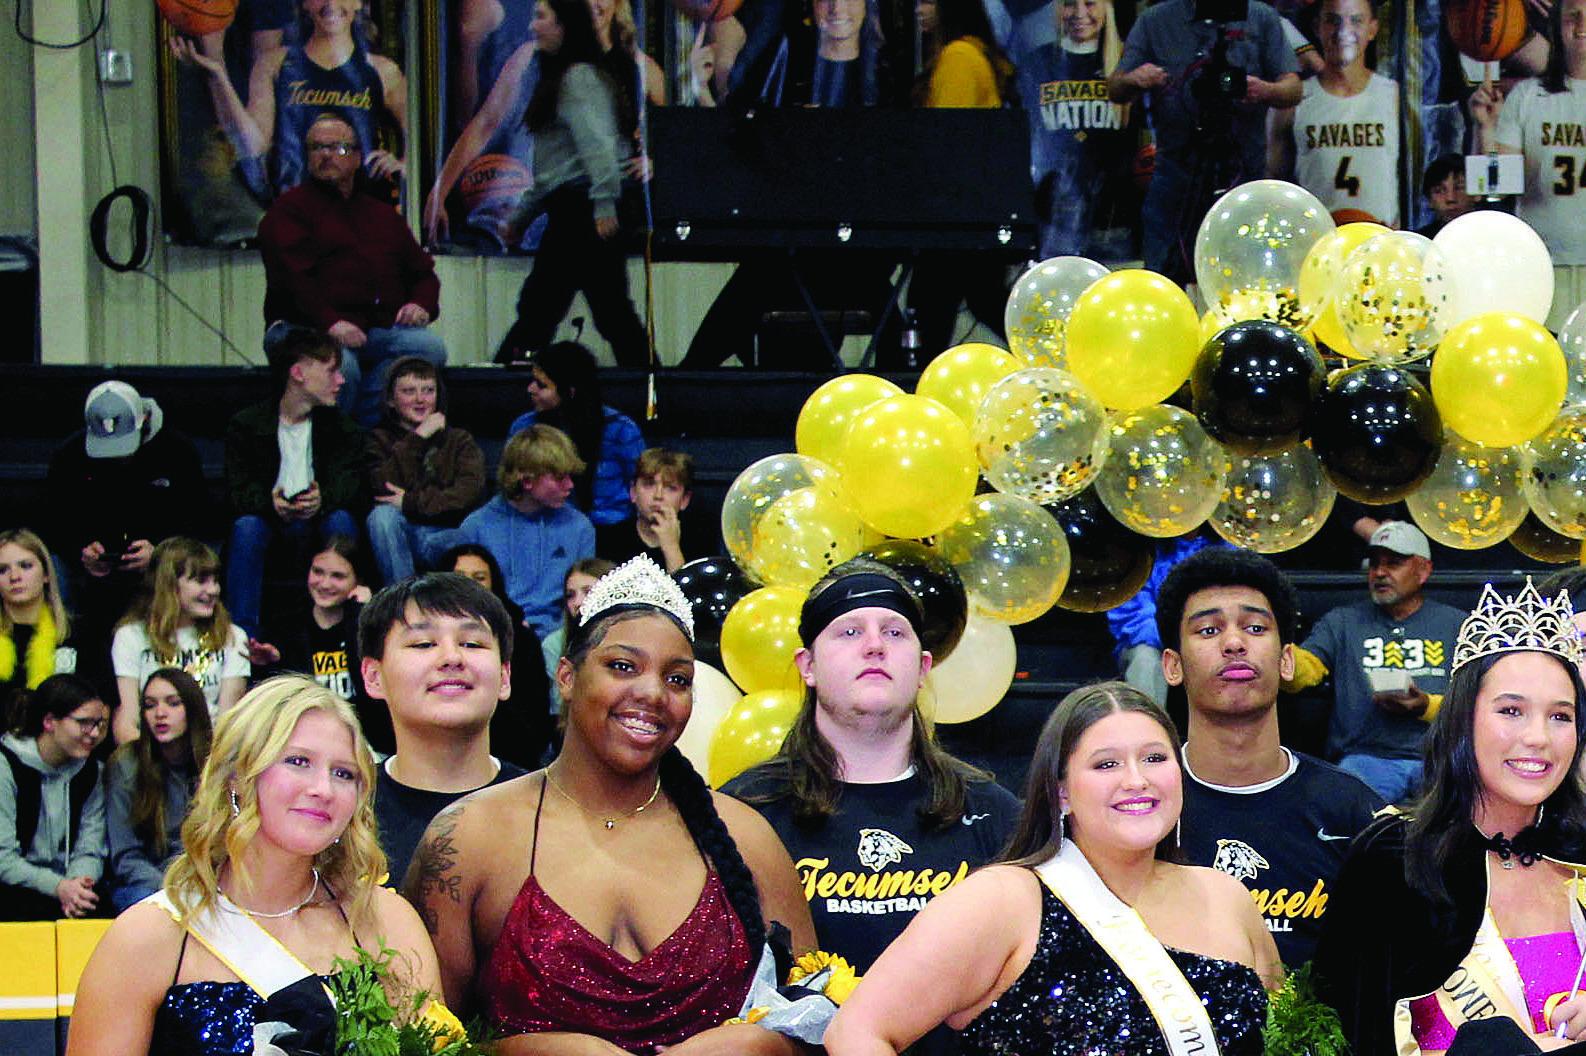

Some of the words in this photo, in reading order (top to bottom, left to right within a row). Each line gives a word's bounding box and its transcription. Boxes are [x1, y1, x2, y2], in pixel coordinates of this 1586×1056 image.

[1042, 82, 1109, 101] SAVAG
[1041, 100, 1131, 131] NATION
[1305, 122, 1386, 150] SAVAGES
[1335, 155, 1360, 198] 4
[826, 897, 927, 916] BASKETBA
